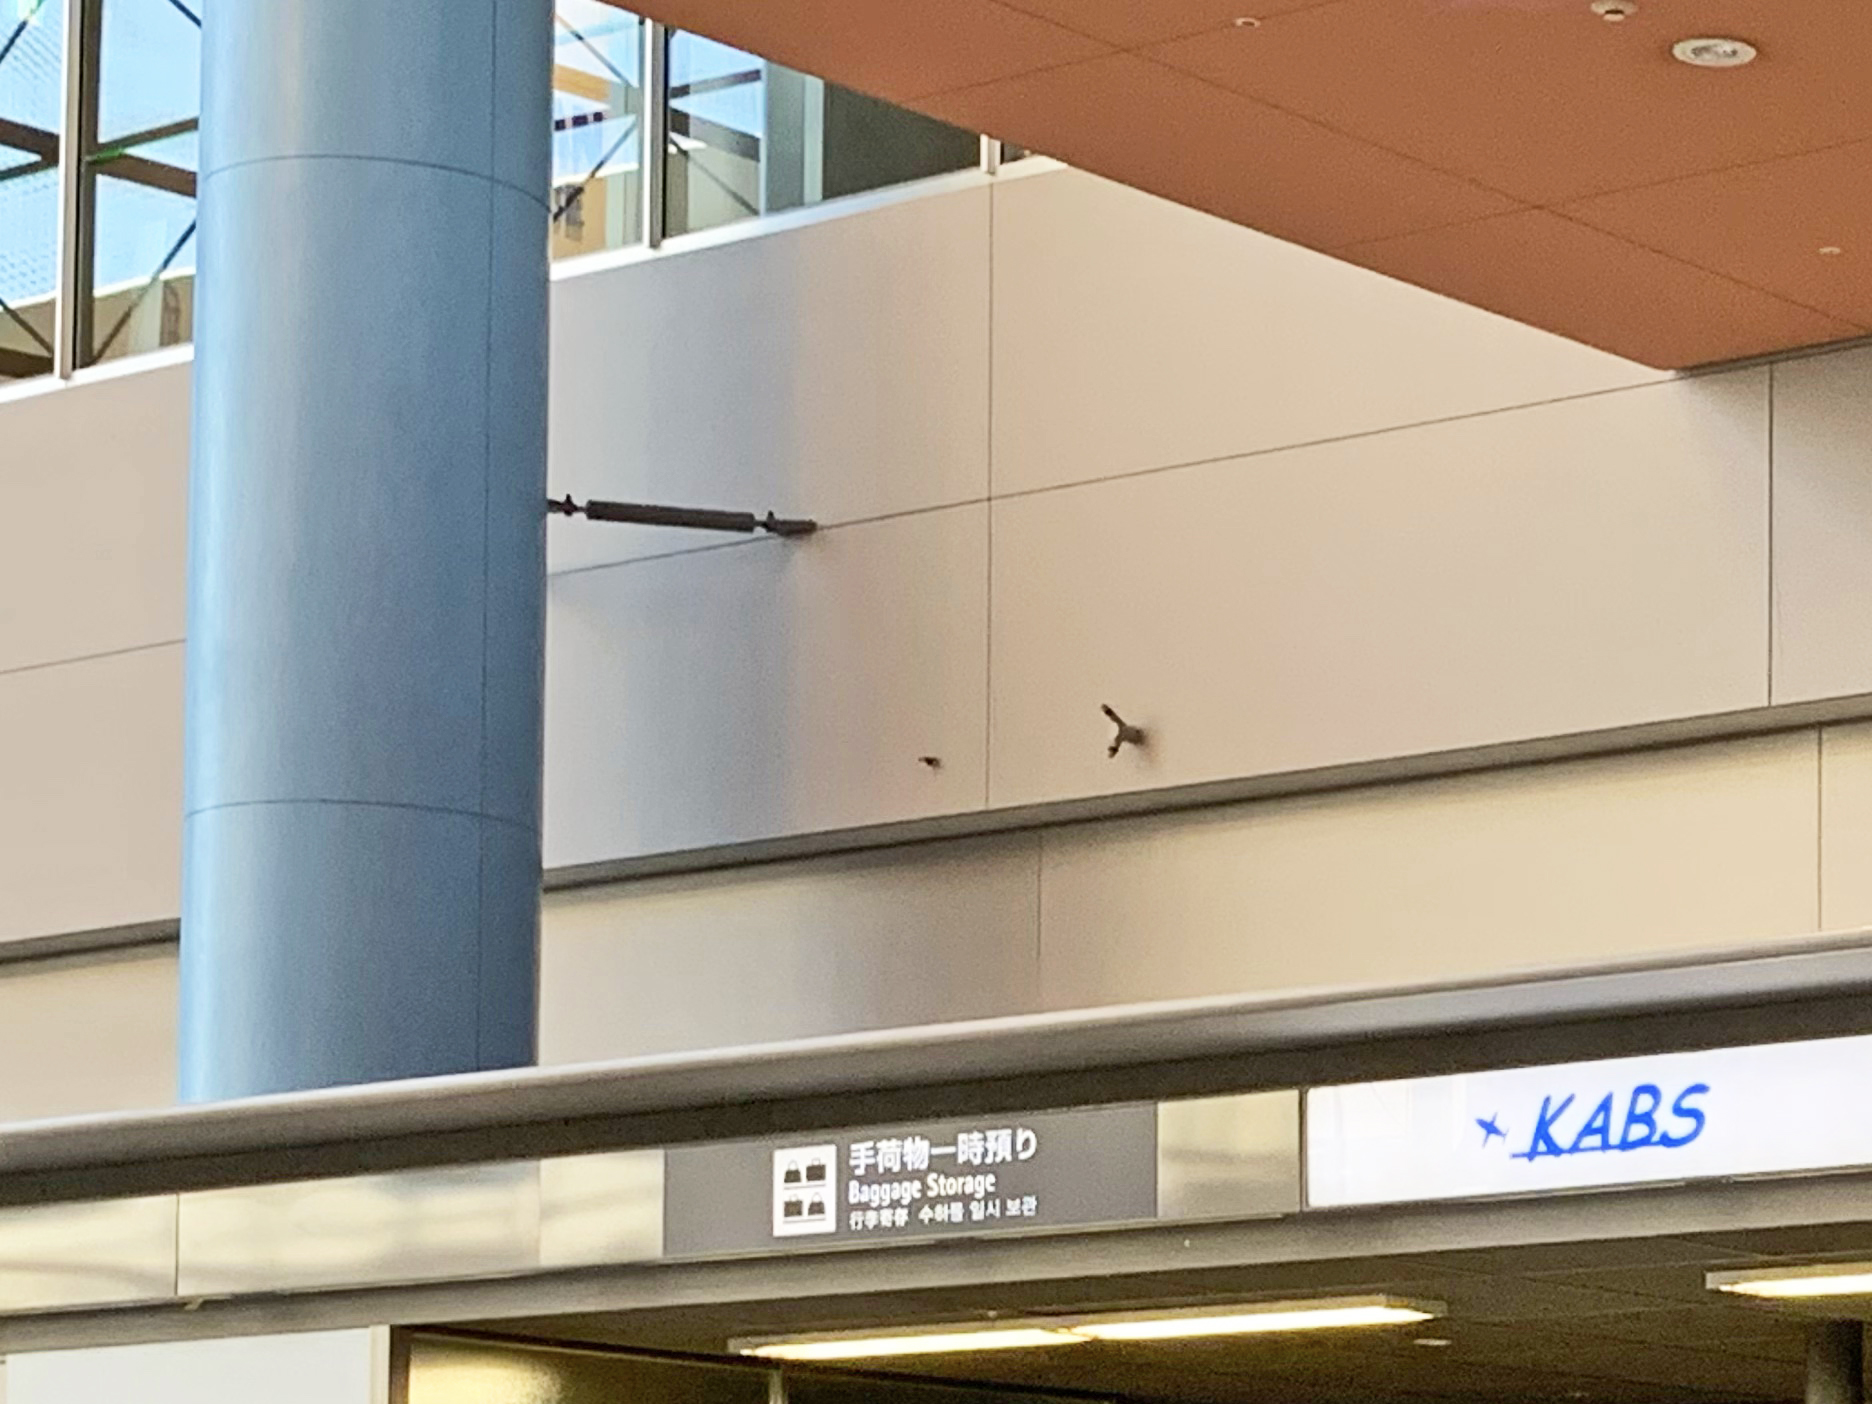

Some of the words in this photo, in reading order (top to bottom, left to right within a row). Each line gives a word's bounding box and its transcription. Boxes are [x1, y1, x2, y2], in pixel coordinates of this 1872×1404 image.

[1526, 1083, 1710, 1161] KABS
[849, 1127, 1038, 1176] 手荷物一時預り
[849, 1179, 922, 1207] Baggage
[926, 1172, 996, 1199] Storage
